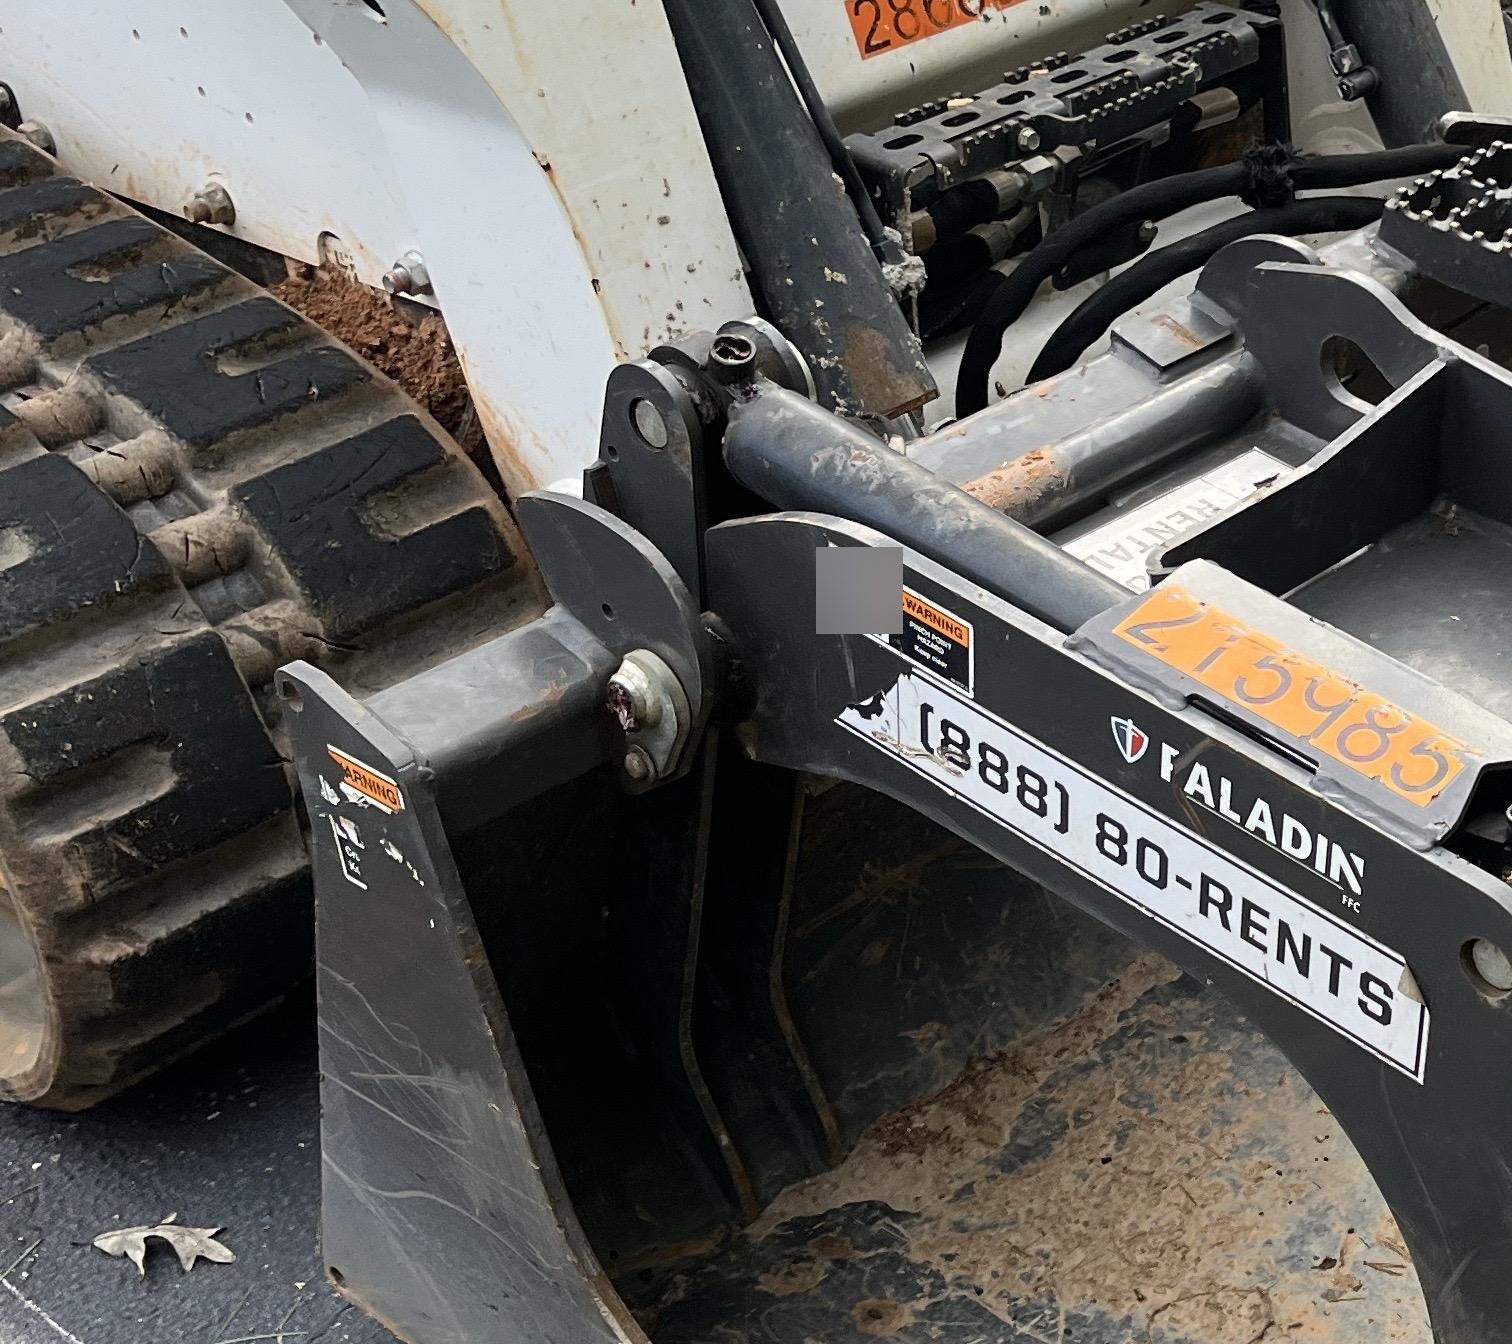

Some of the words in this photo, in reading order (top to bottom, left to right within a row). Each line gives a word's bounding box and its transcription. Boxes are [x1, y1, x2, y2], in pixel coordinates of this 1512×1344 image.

[1082, 498, 1221, 570] RENTAL
[904, 598, 963, 641] WARNING
[1125, 611, 1450, 793] 215985
[344, 765, 397, 805] ARNING
[920, 701, 1070, 834] (888)
[1095, 811, 1394, 1027] 80-RENTS
[1341, 894, 1361, 913] FFC
